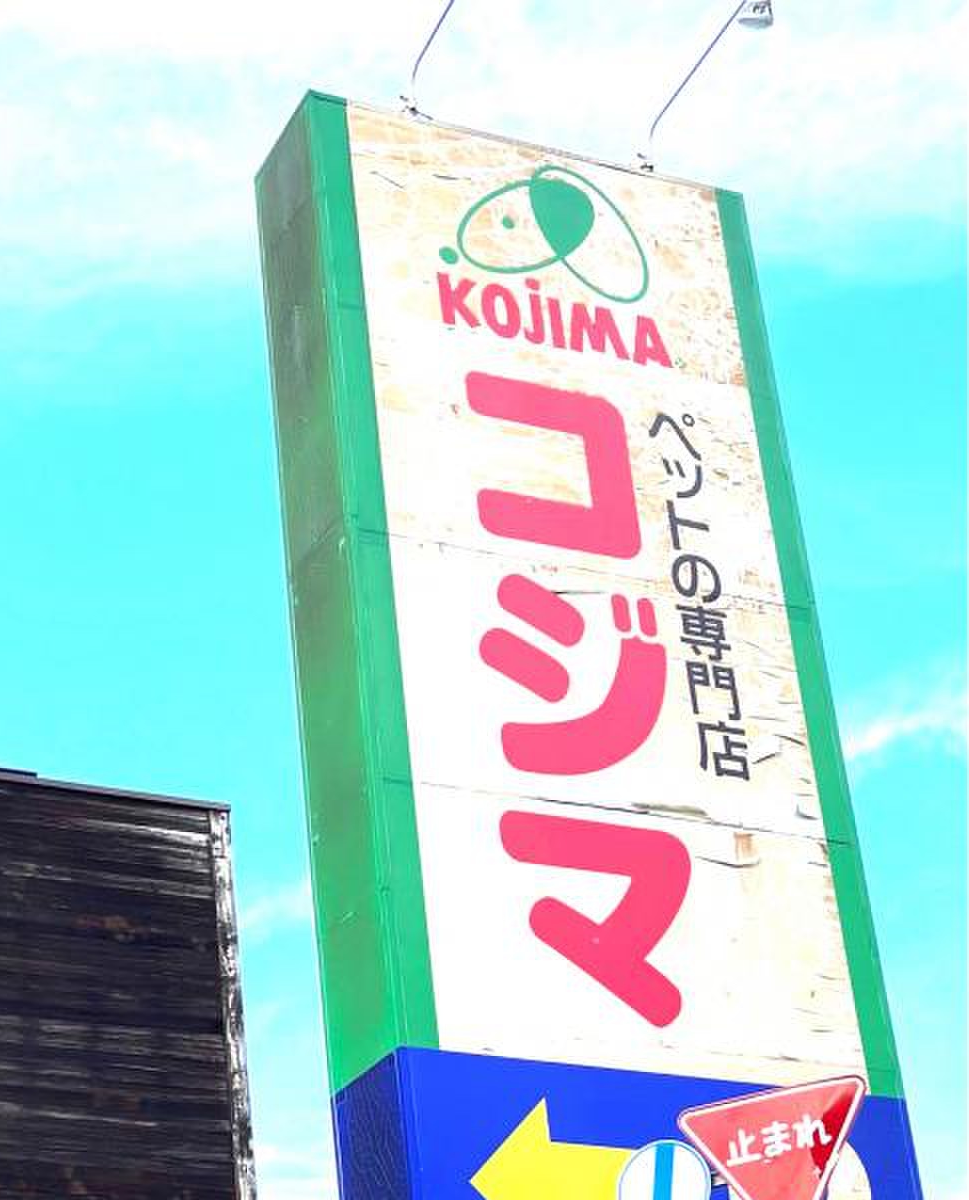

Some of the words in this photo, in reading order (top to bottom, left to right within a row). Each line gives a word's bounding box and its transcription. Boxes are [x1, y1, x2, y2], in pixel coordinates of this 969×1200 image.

[465, 371, 692, 1028] コジマ
[648, 412, 751, 782] ペットの専門店
[727, 1113, 832, 1167] 止まれ
